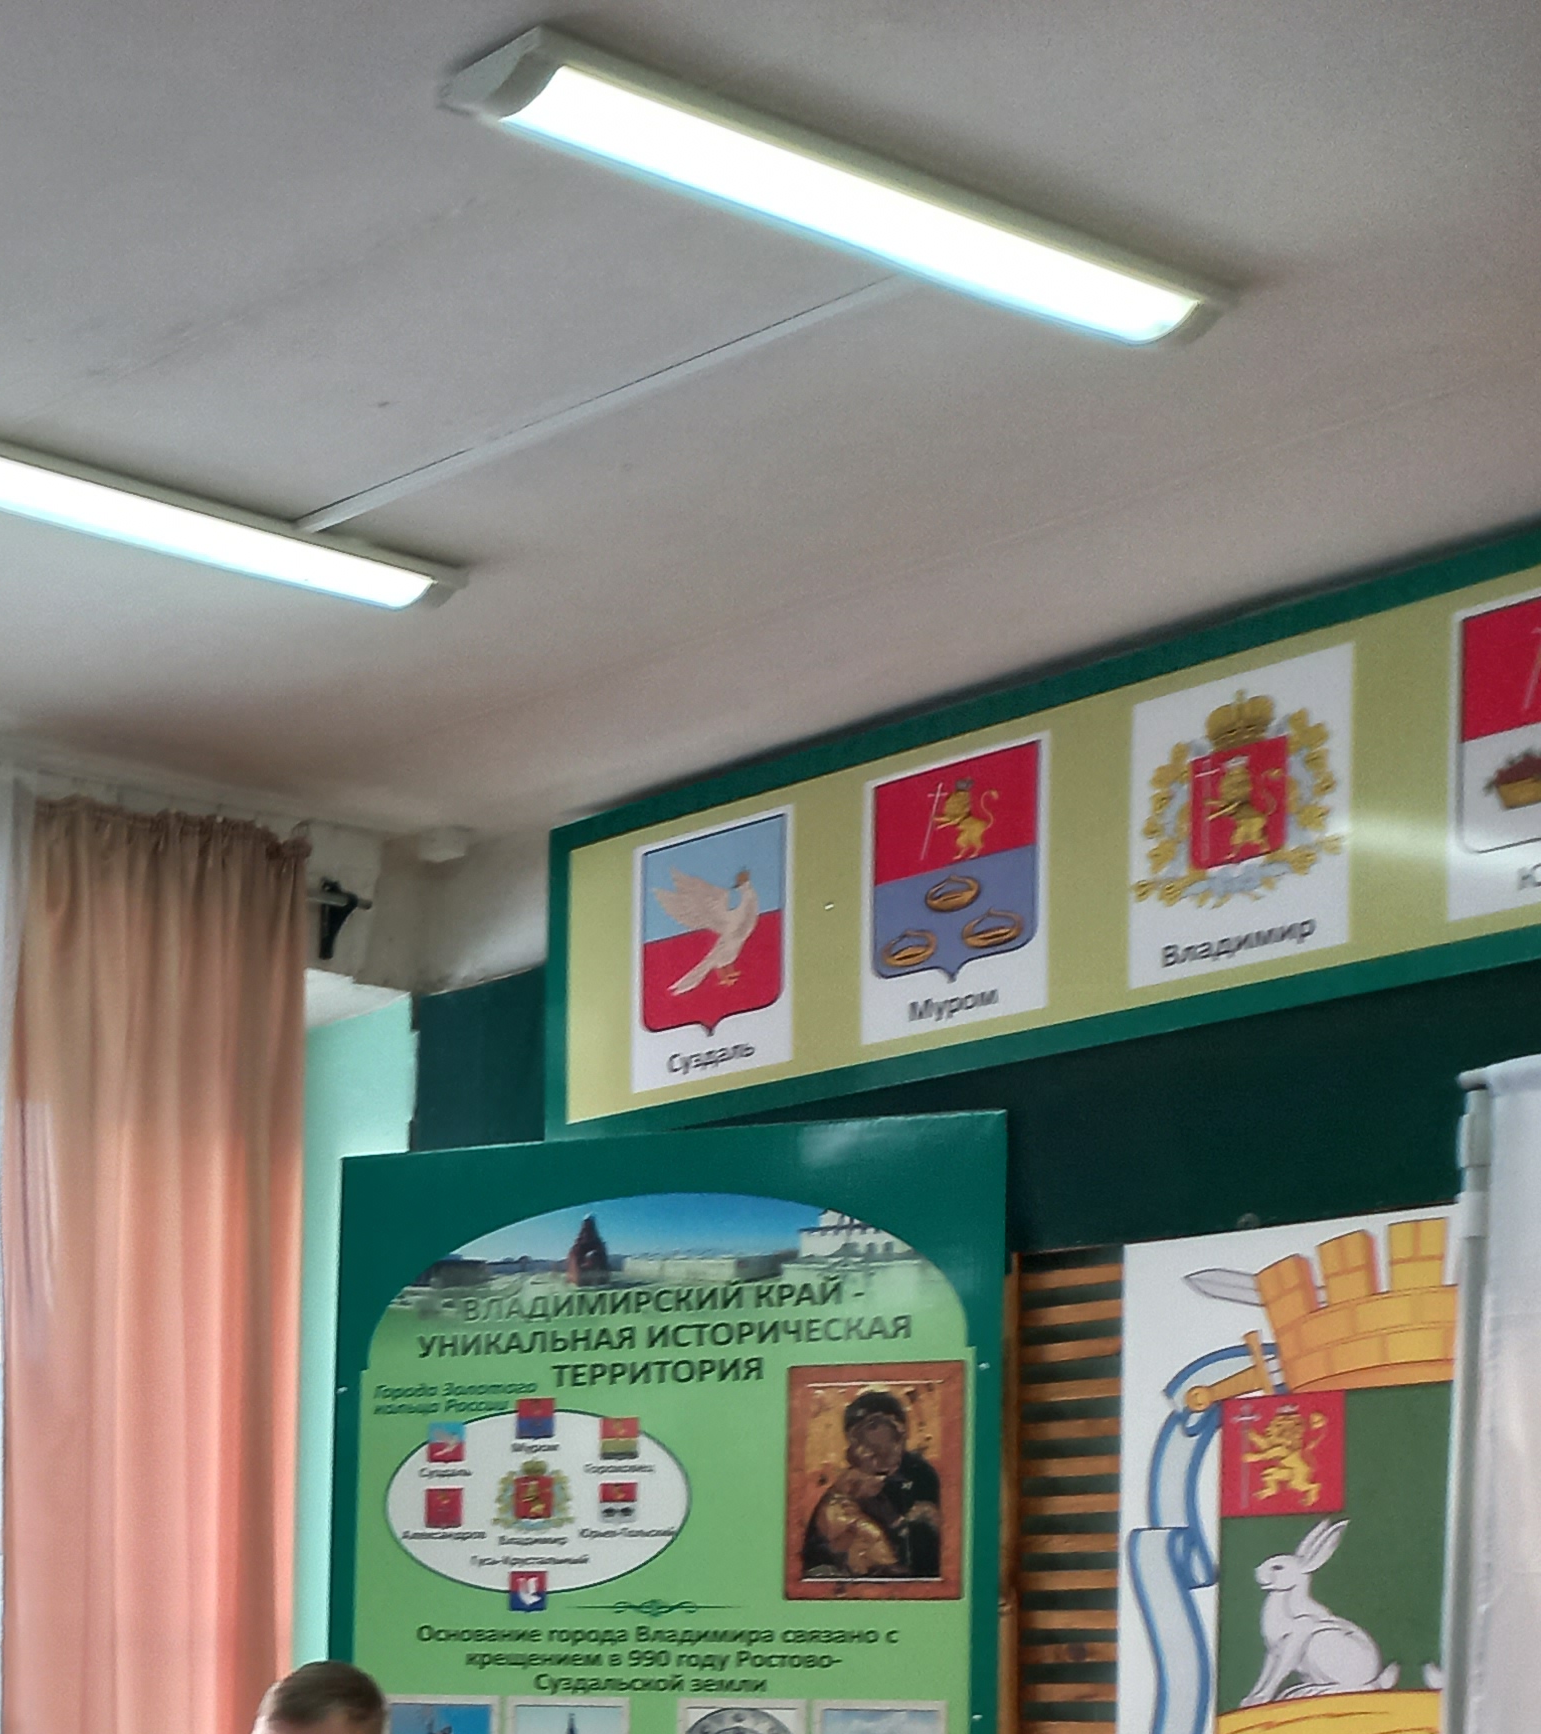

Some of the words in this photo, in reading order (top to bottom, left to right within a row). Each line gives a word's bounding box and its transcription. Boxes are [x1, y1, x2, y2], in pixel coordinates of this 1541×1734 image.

[1161, 918, 1317, 968] Владимир
[907, 987, 1000, 1023] Муром
[666, 1043, 755, 1075] Суздаль
[464, 1281, 745, 1323] ВЛАДИМИРСКИЙ
[754, 1275, 843, 1308] КРАЙ
[416, 1326, 637, 1359] УНИКАЛЬНАЯ
[646, 1314, 913, 1349] ИСТОРИЧЕСКАЯ
[551, 1356, 765, 1388] ТЕРРИТОРИЯ
[416, 1625, 543, 1644] Основание
[547, 1628, 630, 1647] города
[634, 1625, 775, 1647] Владимира
[781, 1629, 880, 1645] связано
[885, 1629, 899, 1645] с
[465, 1652, 602, 1670] крещением
[608, 1652, 622, 1667] в
[627, 1649, 669, 1669] 990
[674, 1653, 730, 1672] году
[735, 1650, 843, 1669] Ростово-
[533, 1673, 685, 1695] Суздальской
[690, 1675, 768, 1693] земли
